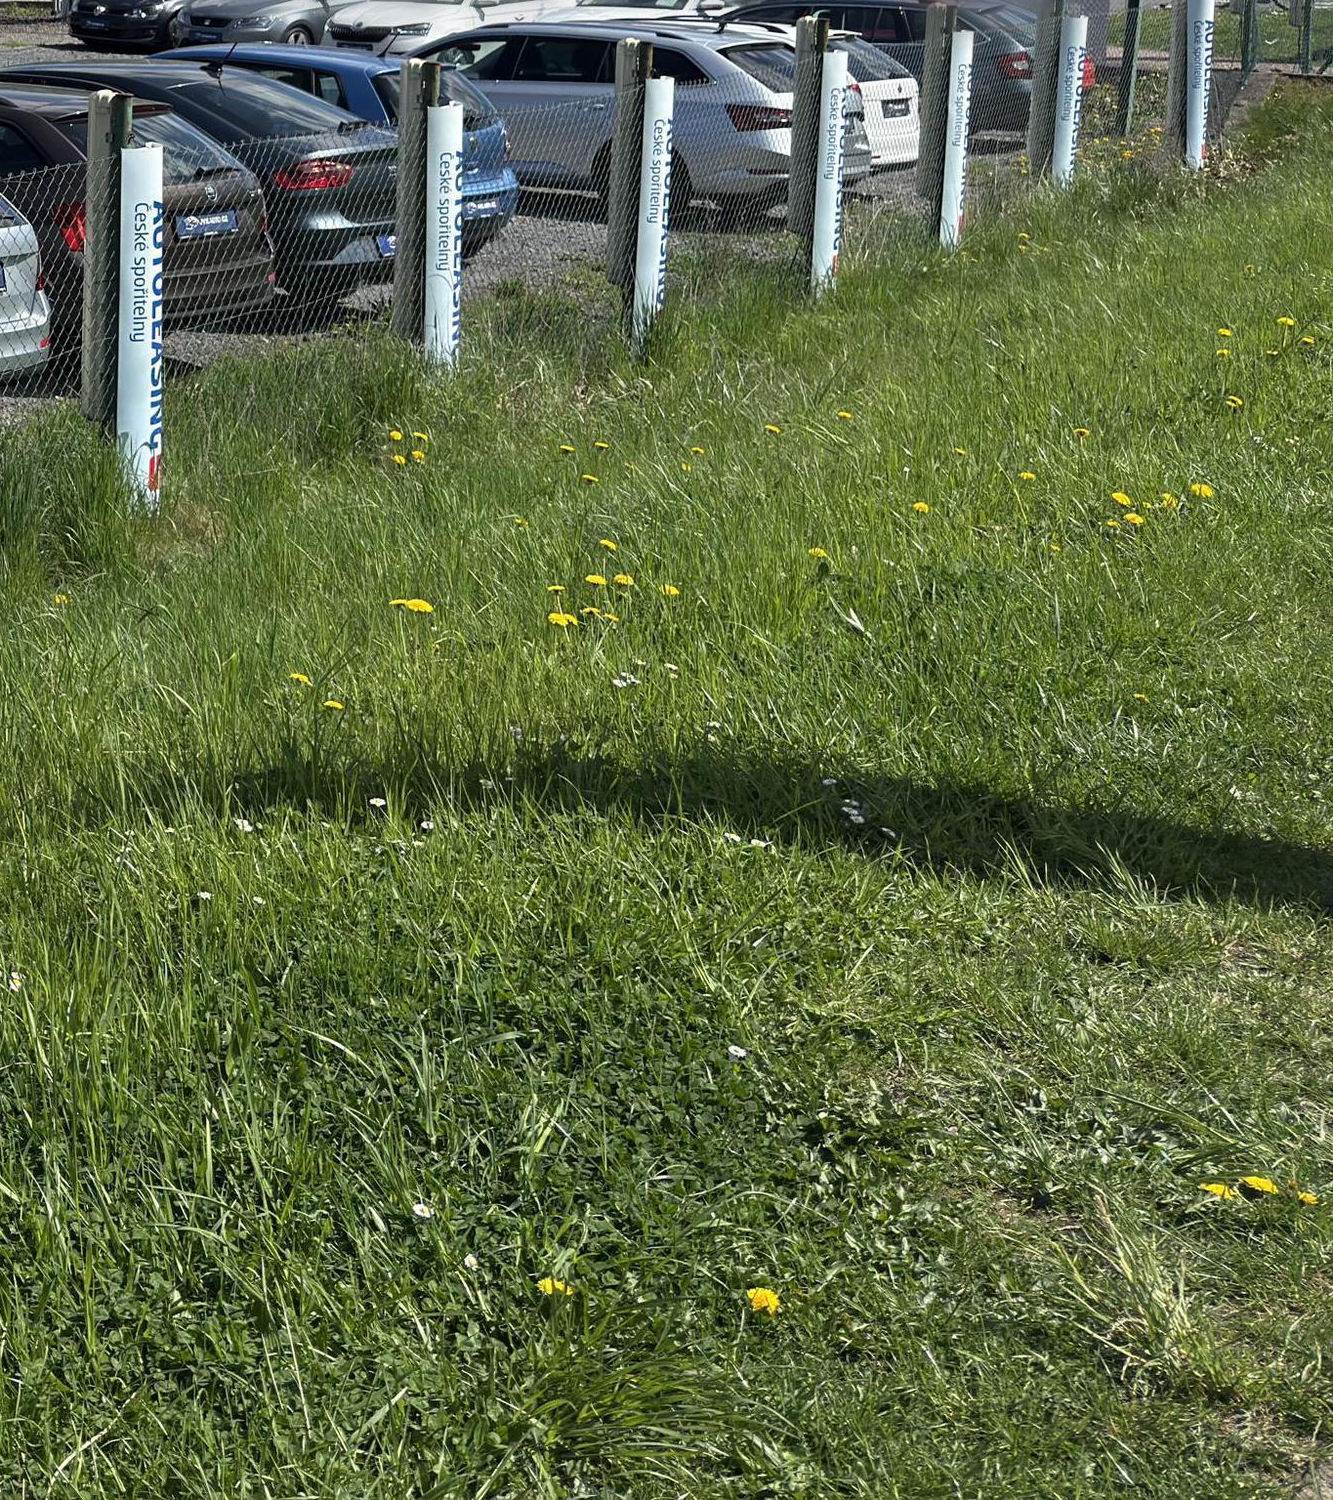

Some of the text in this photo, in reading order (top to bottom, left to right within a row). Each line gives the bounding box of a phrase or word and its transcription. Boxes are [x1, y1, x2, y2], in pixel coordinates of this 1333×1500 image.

[435, 152, 455, 271] České spořitelny
[647, 119, 665, 224] České spořitelny
[129, 202, 153, 343] České spořitelny
